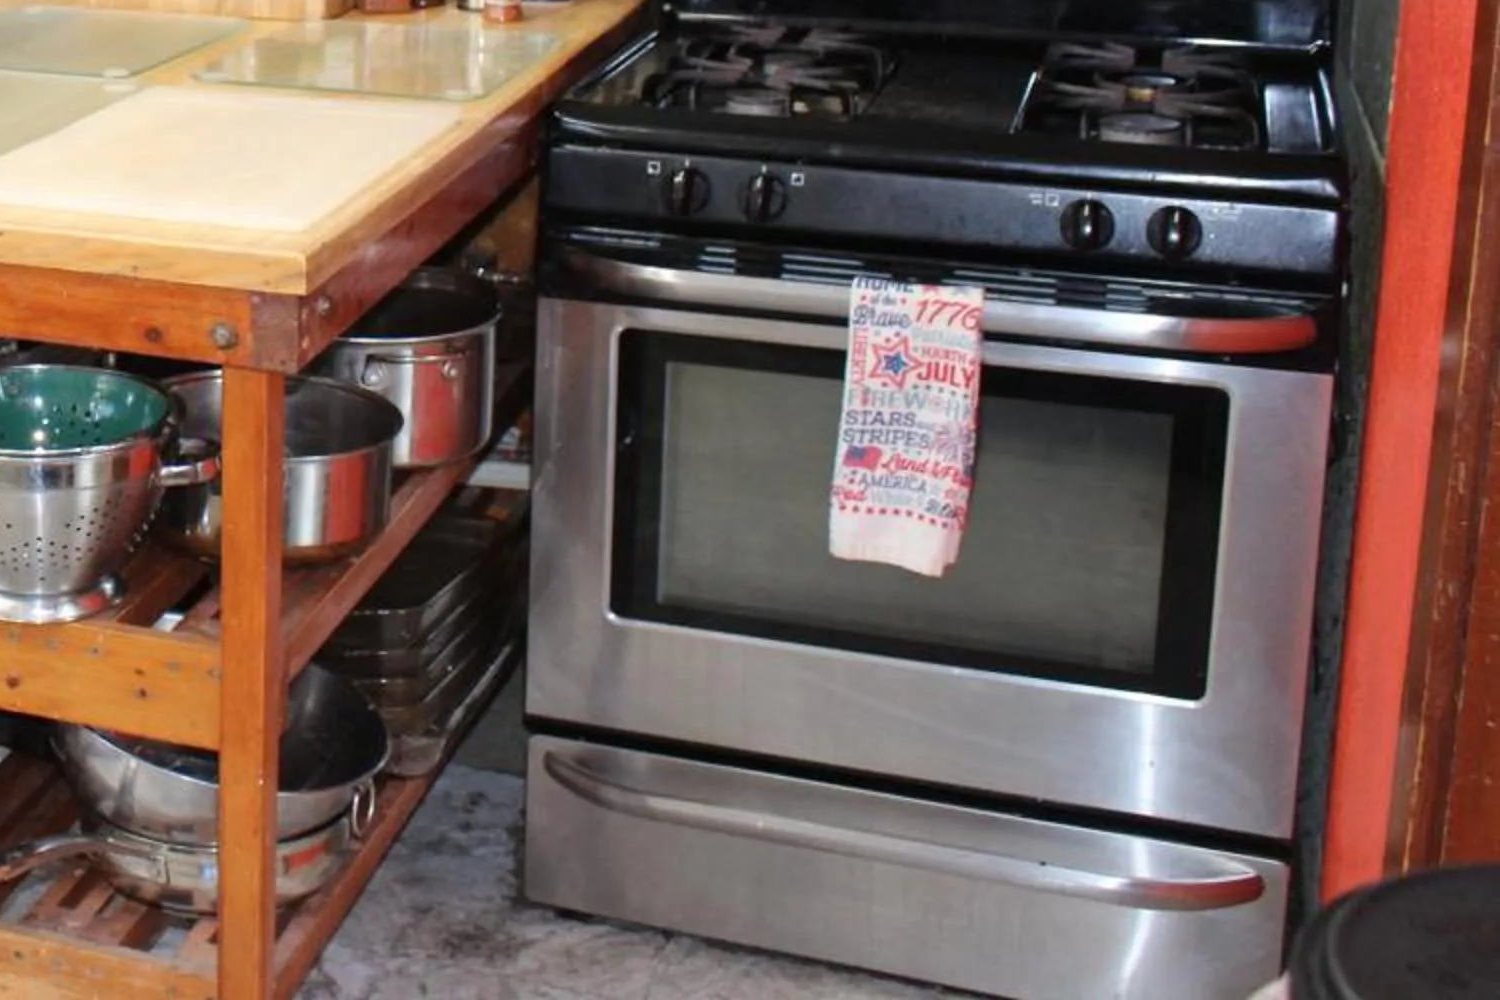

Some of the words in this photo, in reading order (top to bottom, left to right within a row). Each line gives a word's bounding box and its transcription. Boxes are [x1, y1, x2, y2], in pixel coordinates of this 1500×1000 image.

[852, 304, 913, 329] Brave
[915, 298, 982, 331] 1776
[917, 361, 976, 390] JULY
[845, 409, 916, 428] STARS
[843, 427, 931, 450] STRIPES
[859, 473, 927, 495] AMERICA
